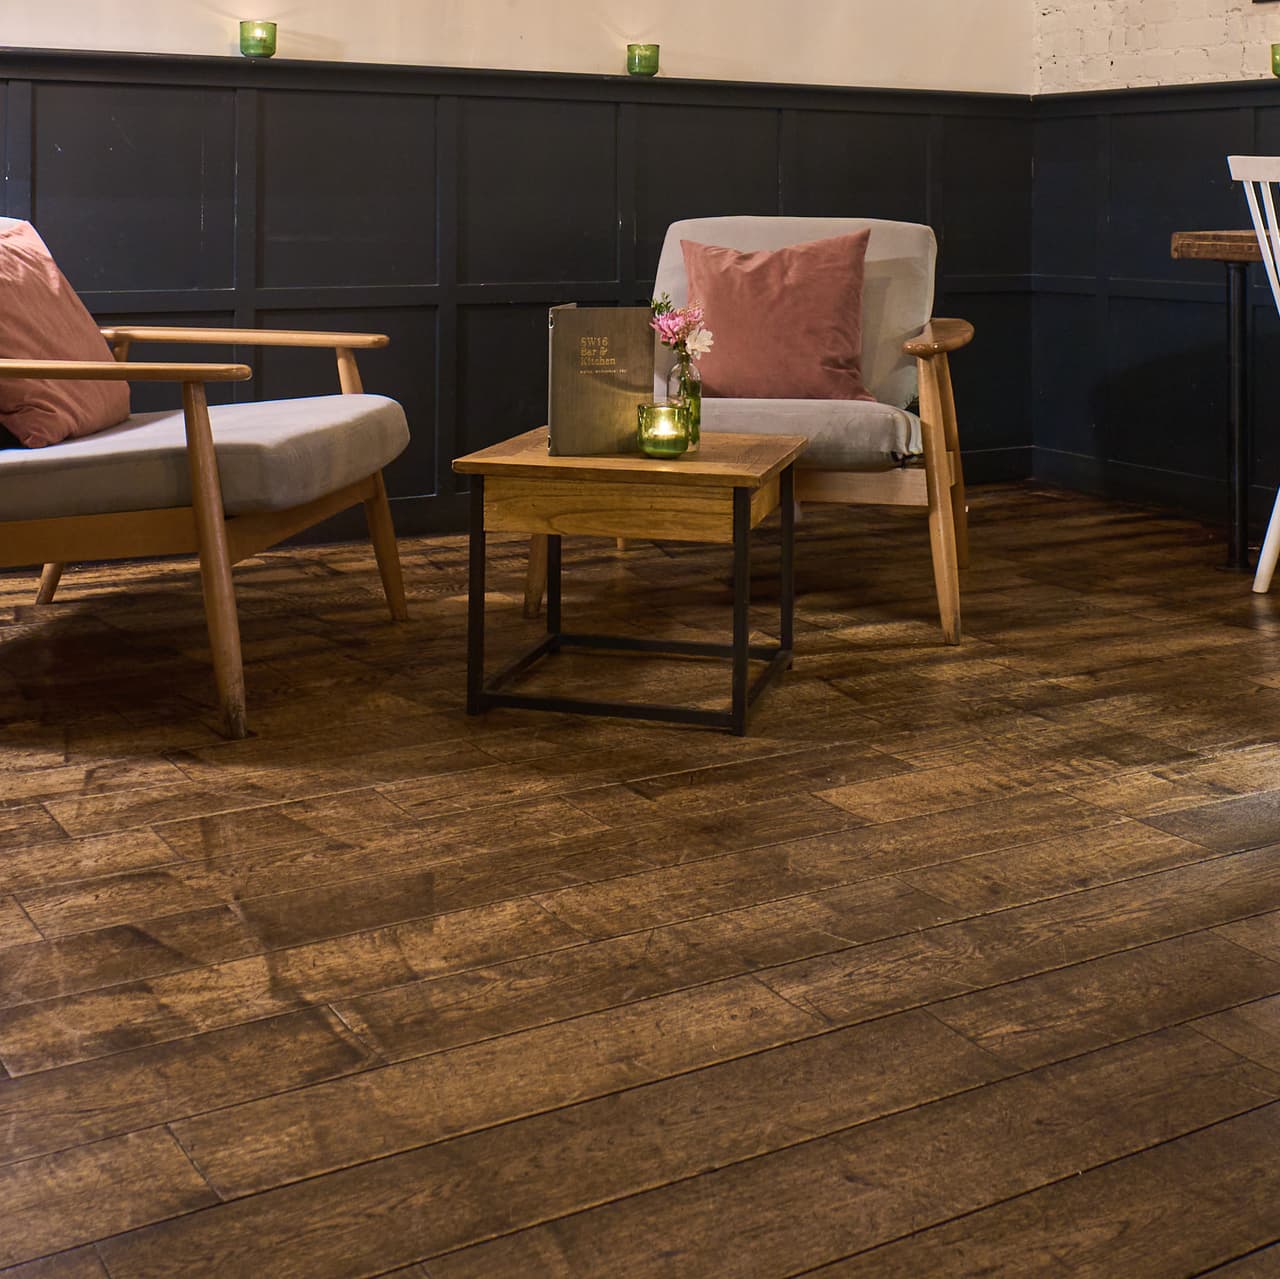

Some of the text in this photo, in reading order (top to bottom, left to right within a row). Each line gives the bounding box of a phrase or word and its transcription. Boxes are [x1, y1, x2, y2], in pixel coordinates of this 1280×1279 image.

[580, 336, 609, 347] SW16
[580, 347, 597, 356] Bar
[580, 357, 616, 366] Kitchen
